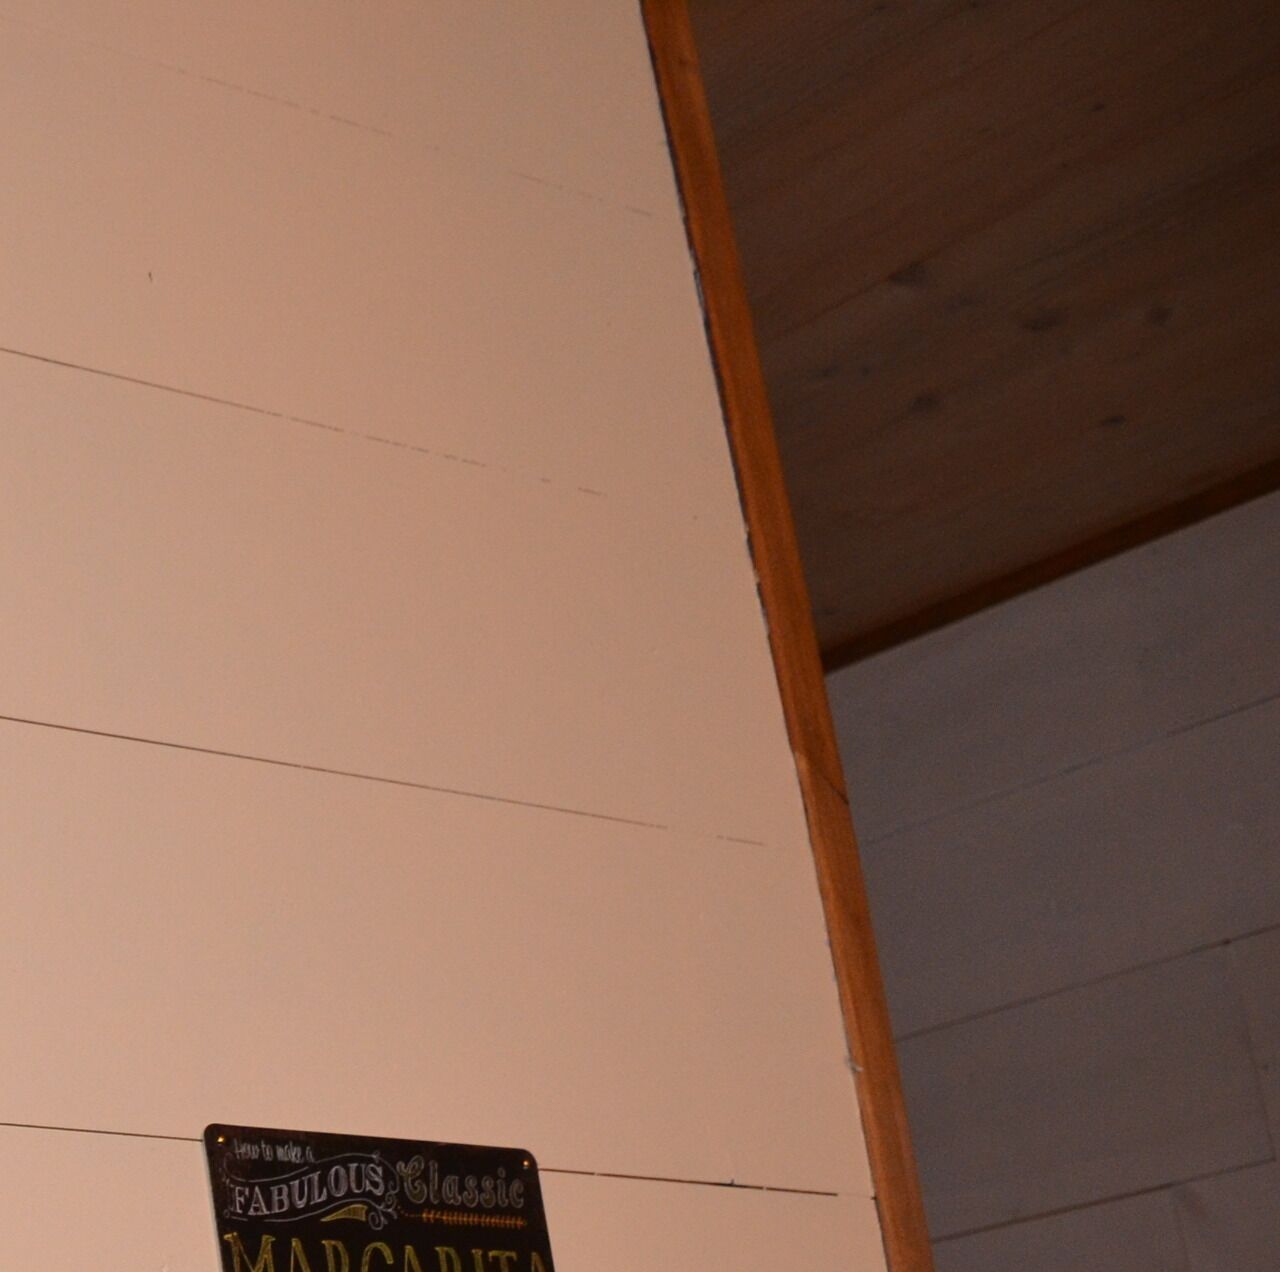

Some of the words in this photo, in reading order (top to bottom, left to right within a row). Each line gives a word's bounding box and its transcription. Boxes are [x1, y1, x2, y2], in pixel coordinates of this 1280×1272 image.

[261, 1141, 274, 1160] to
[276, 1143, 304, 1163] make
[232, 1162, 385, 1216] FABULOUS
[396, 1154, 524, 1208] Classic
